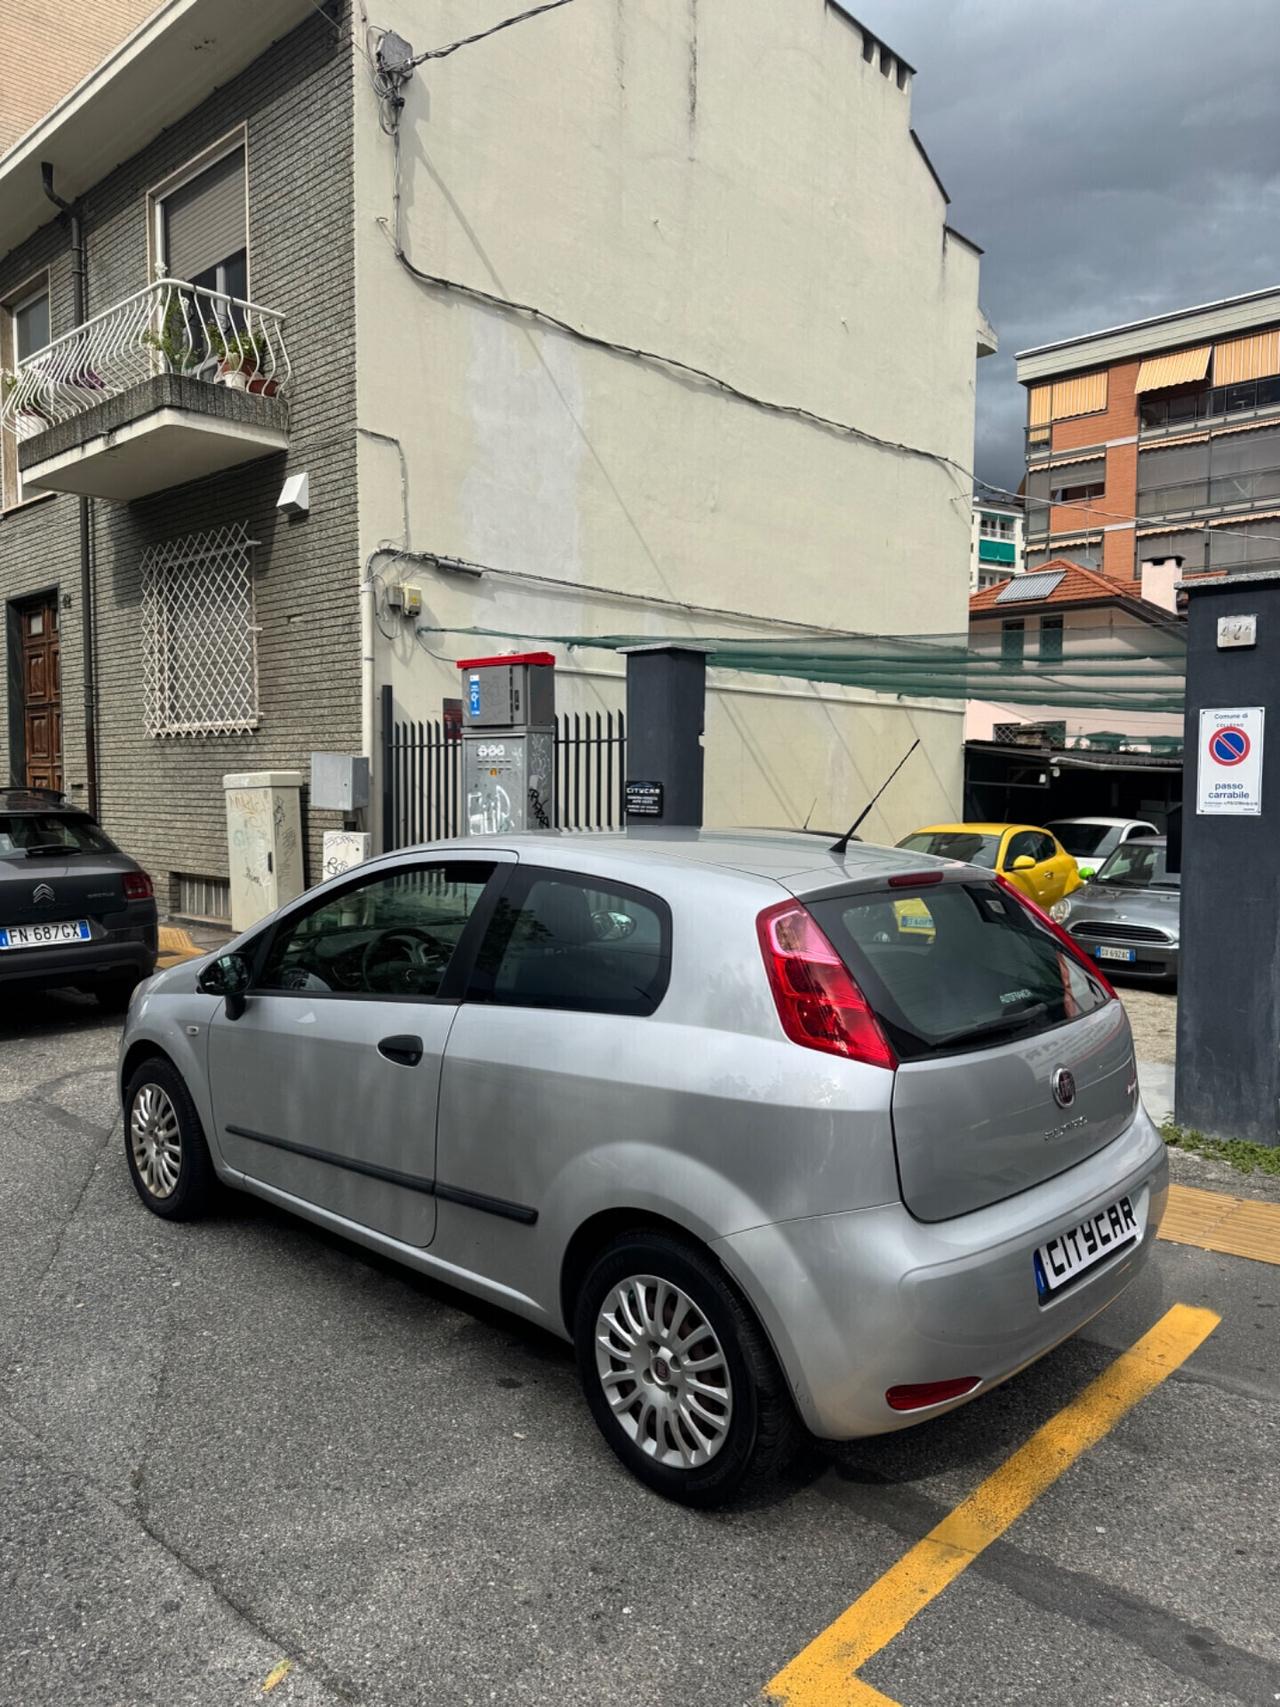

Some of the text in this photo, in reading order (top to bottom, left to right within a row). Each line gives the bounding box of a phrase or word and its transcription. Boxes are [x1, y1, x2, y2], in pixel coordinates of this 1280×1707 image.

[1215, 783, 1243, 791] passo
[1208, 791, 1249, 799] carrabile
[34, 923, 80, 941] 687GX
[1046, 1196, 1137, 1277] CITYCAR
